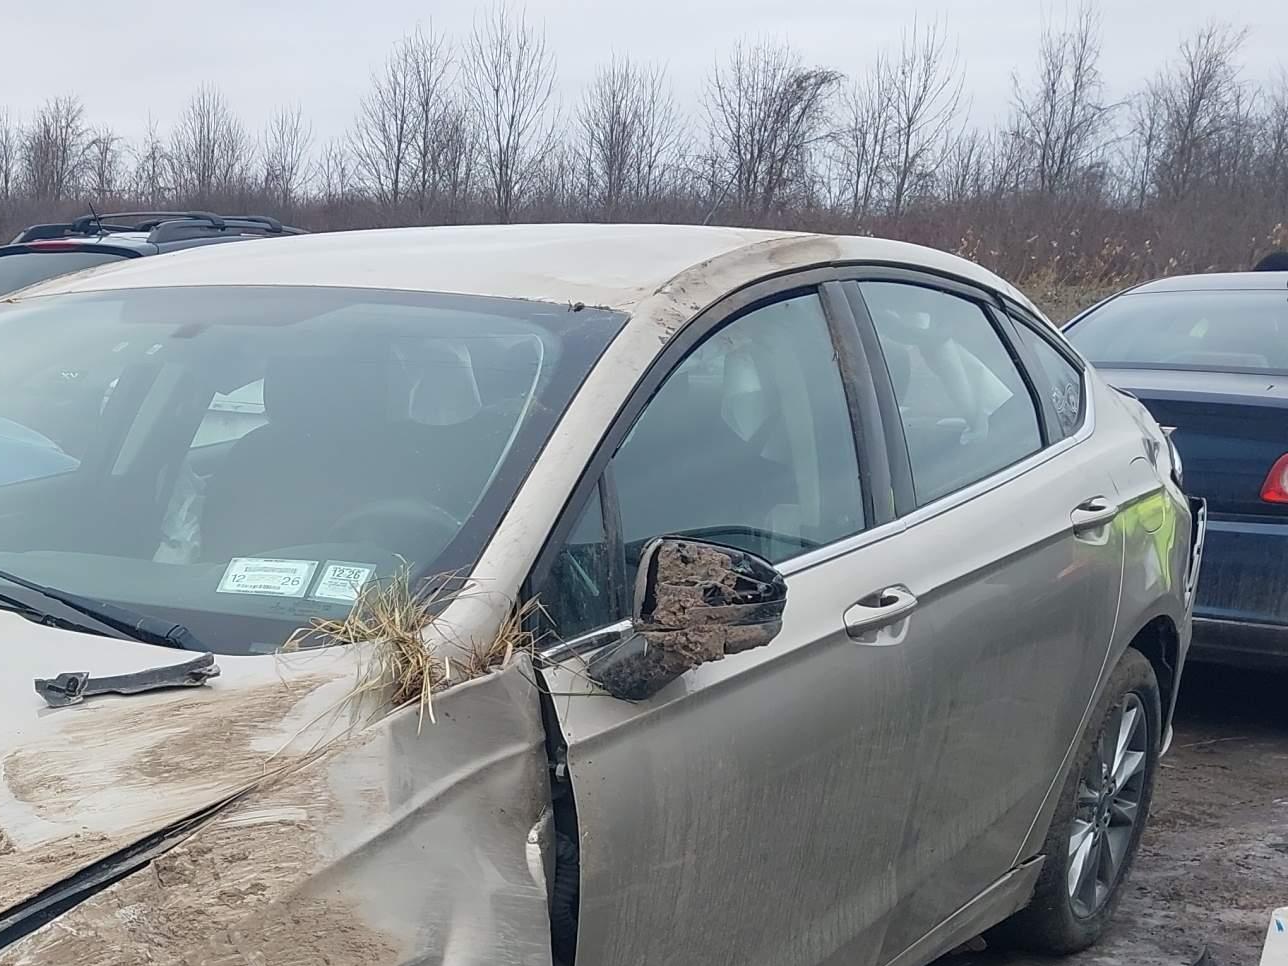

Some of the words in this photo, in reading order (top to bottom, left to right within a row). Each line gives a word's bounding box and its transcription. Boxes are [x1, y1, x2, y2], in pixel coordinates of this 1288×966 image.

[332, 567, 344, 578] 12
[345, 568, 361, 580] 26
[231, 574, 246, 583] 12
[280, 576, 301, 586] 26
